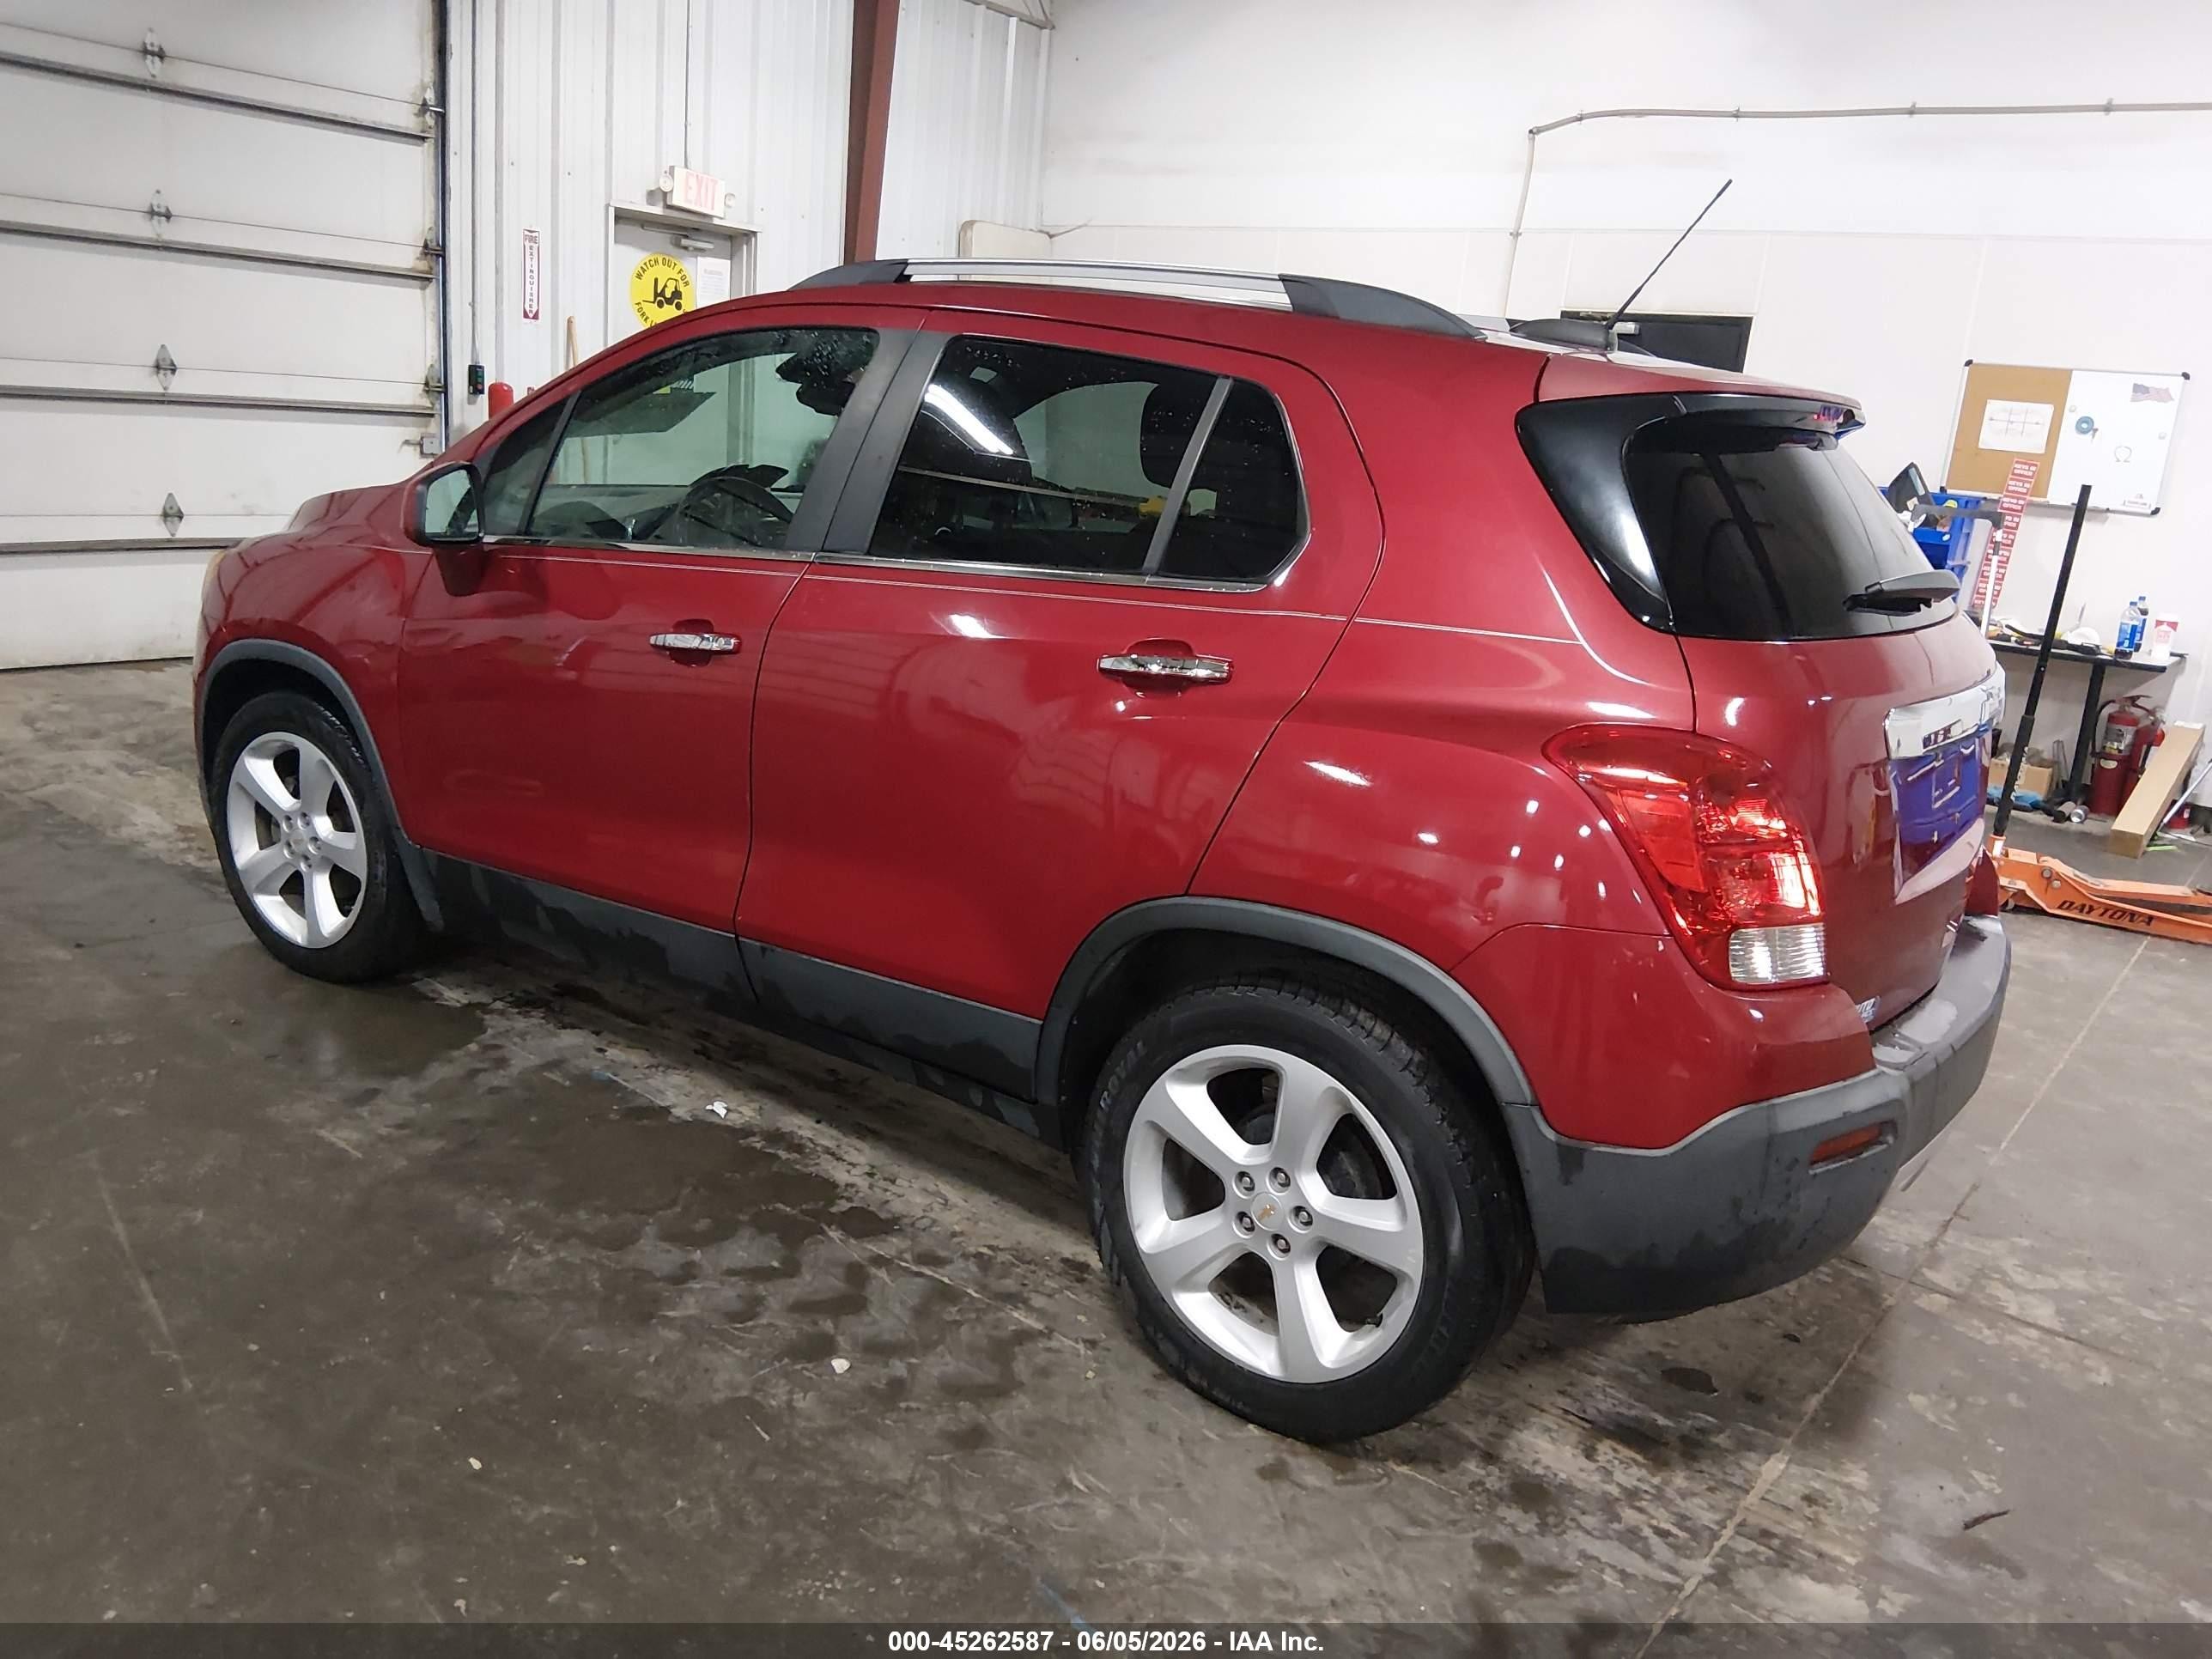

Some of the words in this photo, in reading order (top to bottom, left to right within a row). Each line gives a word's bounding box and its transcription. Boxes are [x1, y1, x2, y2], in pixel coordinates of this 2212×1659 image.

[684, 172, 719, 210] EXIT
[525, 234, 538, 244] FIRE
[635, 257, 659, 281] WATCH
[662, 257, 678, 270] OUT
[677, 268, 690, 288] FOR
[635, 301, 651, 324] FORK
[2057, 900, 2154, 927] DAYTONA
